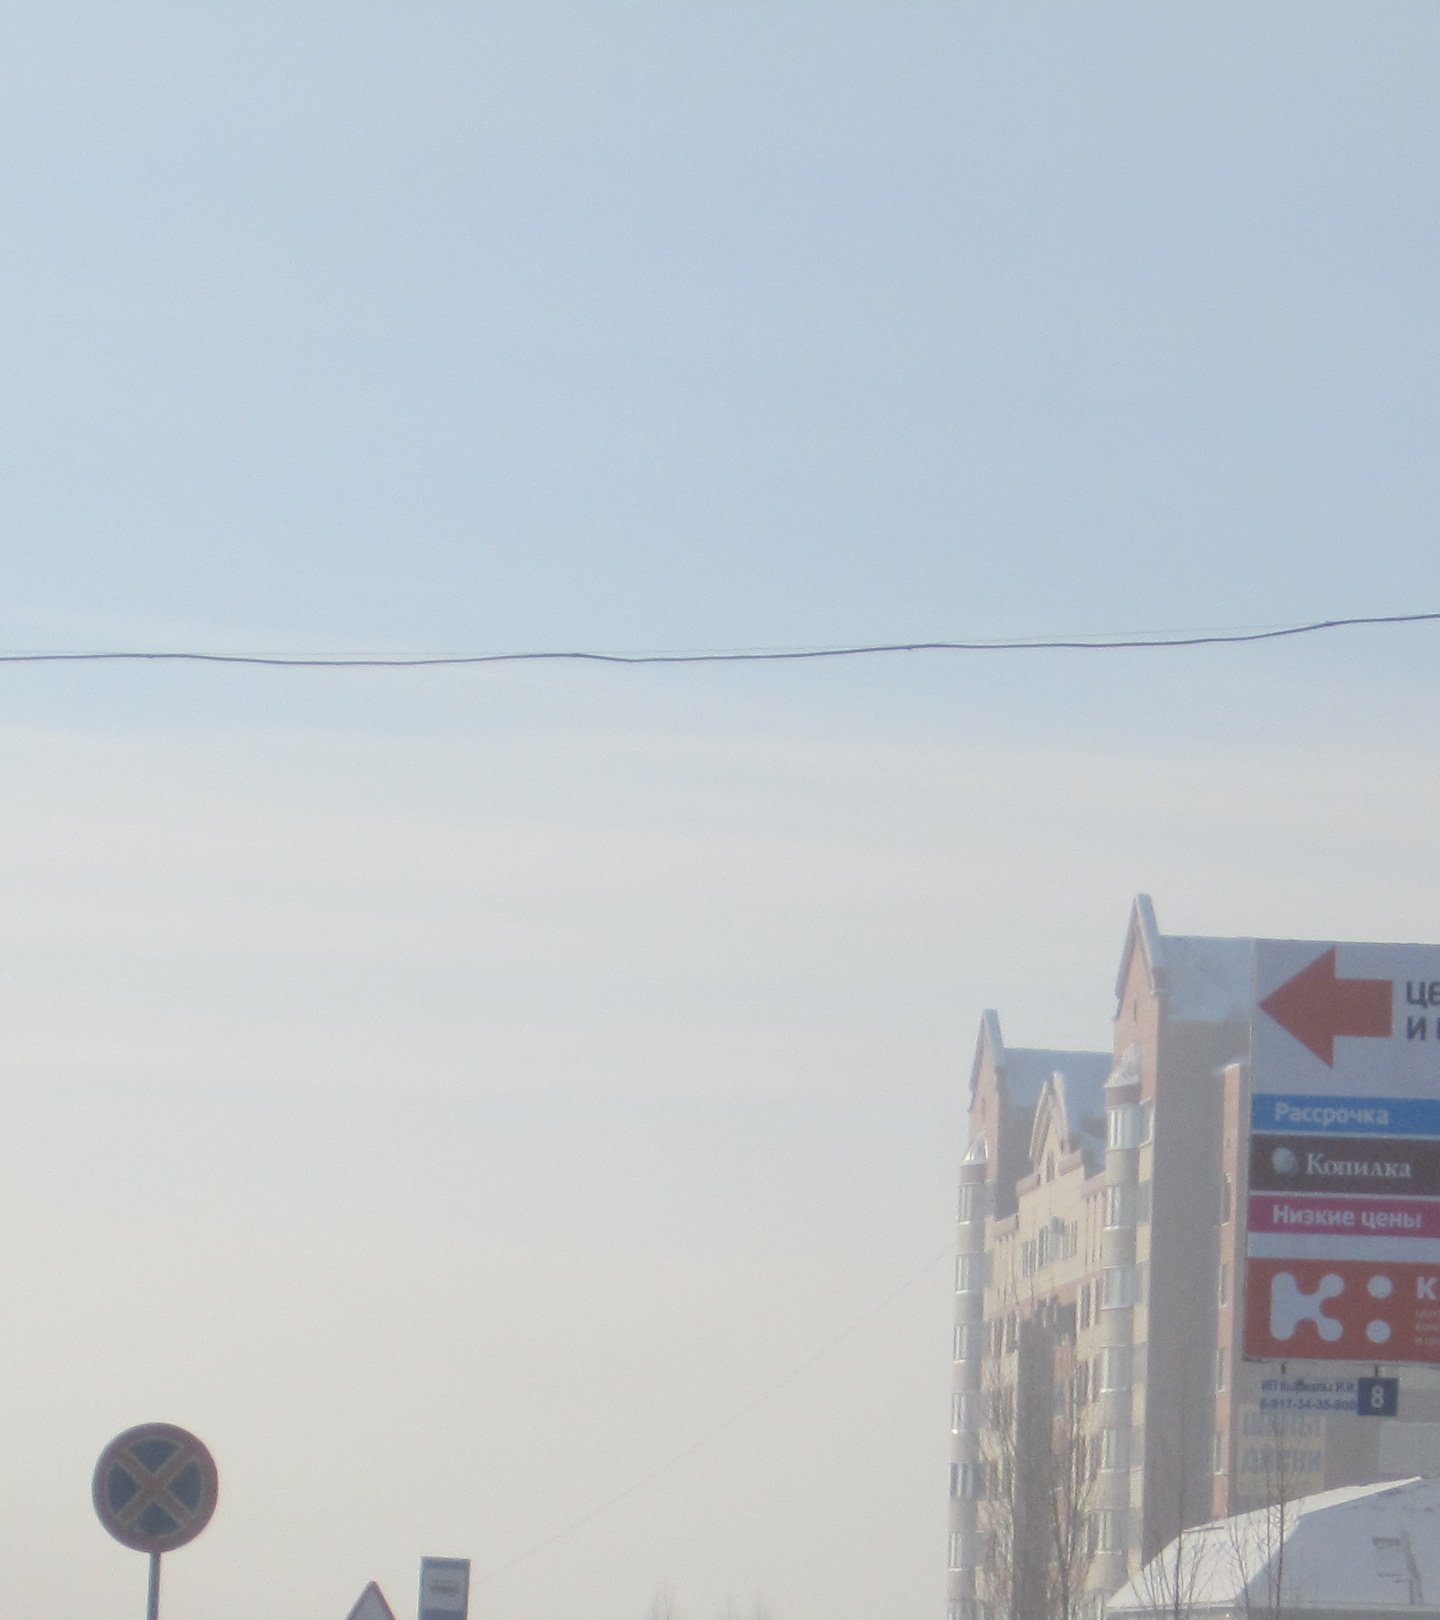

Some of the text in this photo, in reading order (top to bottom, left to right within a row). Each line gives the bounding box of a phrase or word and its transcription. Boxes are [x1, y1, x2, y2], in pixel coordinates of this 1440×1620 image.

[1406, 1016, 1427, 1041] И
[1275, 1102, 1390, 1126] Рассрочка
[1305, 1152, 1412, 1178] Копилка
[1272, 1204, 1423, 1230] Низкие цены
[1370, 1385, 1384, 1408] 8
